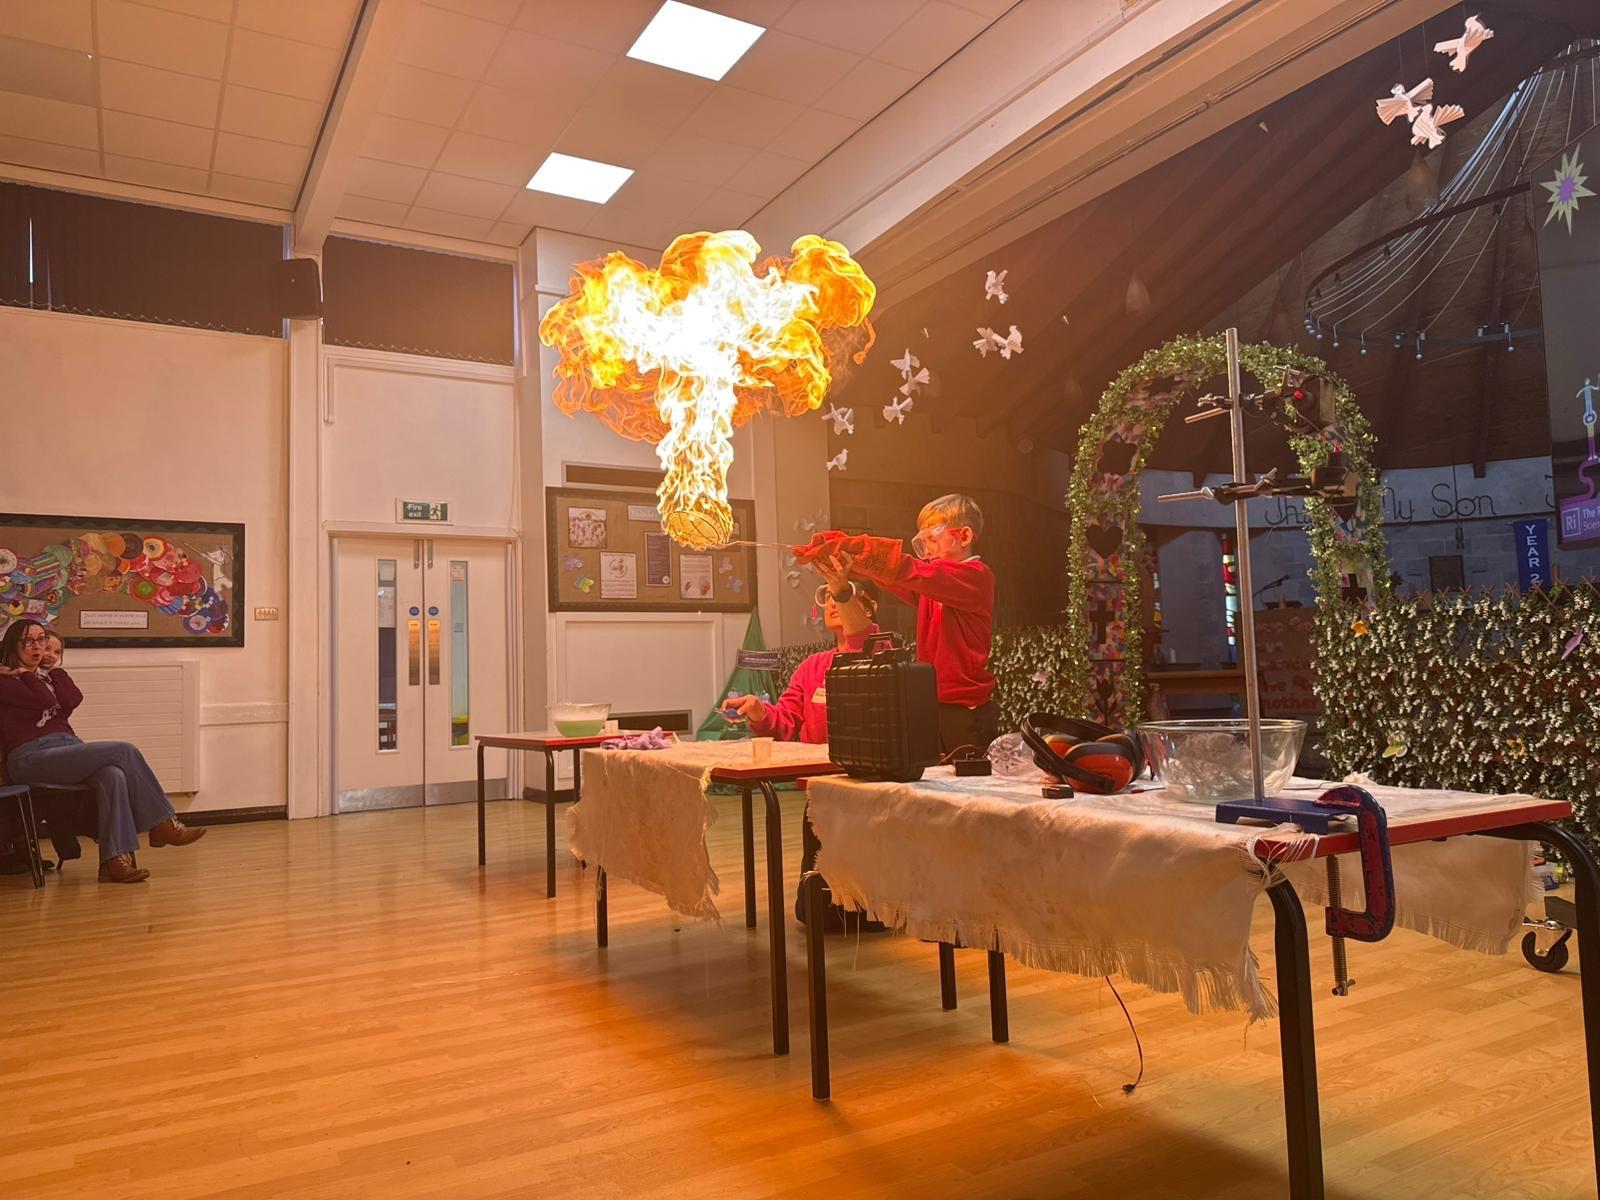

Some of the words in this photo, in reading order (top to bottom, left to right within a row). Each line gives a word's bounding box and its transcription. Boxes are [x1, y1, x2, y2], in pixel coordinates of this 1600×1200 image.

[407, 503, 423, 511] Fire
[1431, 483, 1496, 518] Son
[1582, 508, 1597, 519] The
[1566, 514, 1577, 531] Ri
[1525, 524, 1540, 568] YEAR
[1530, 573, 1543, 584] 2
